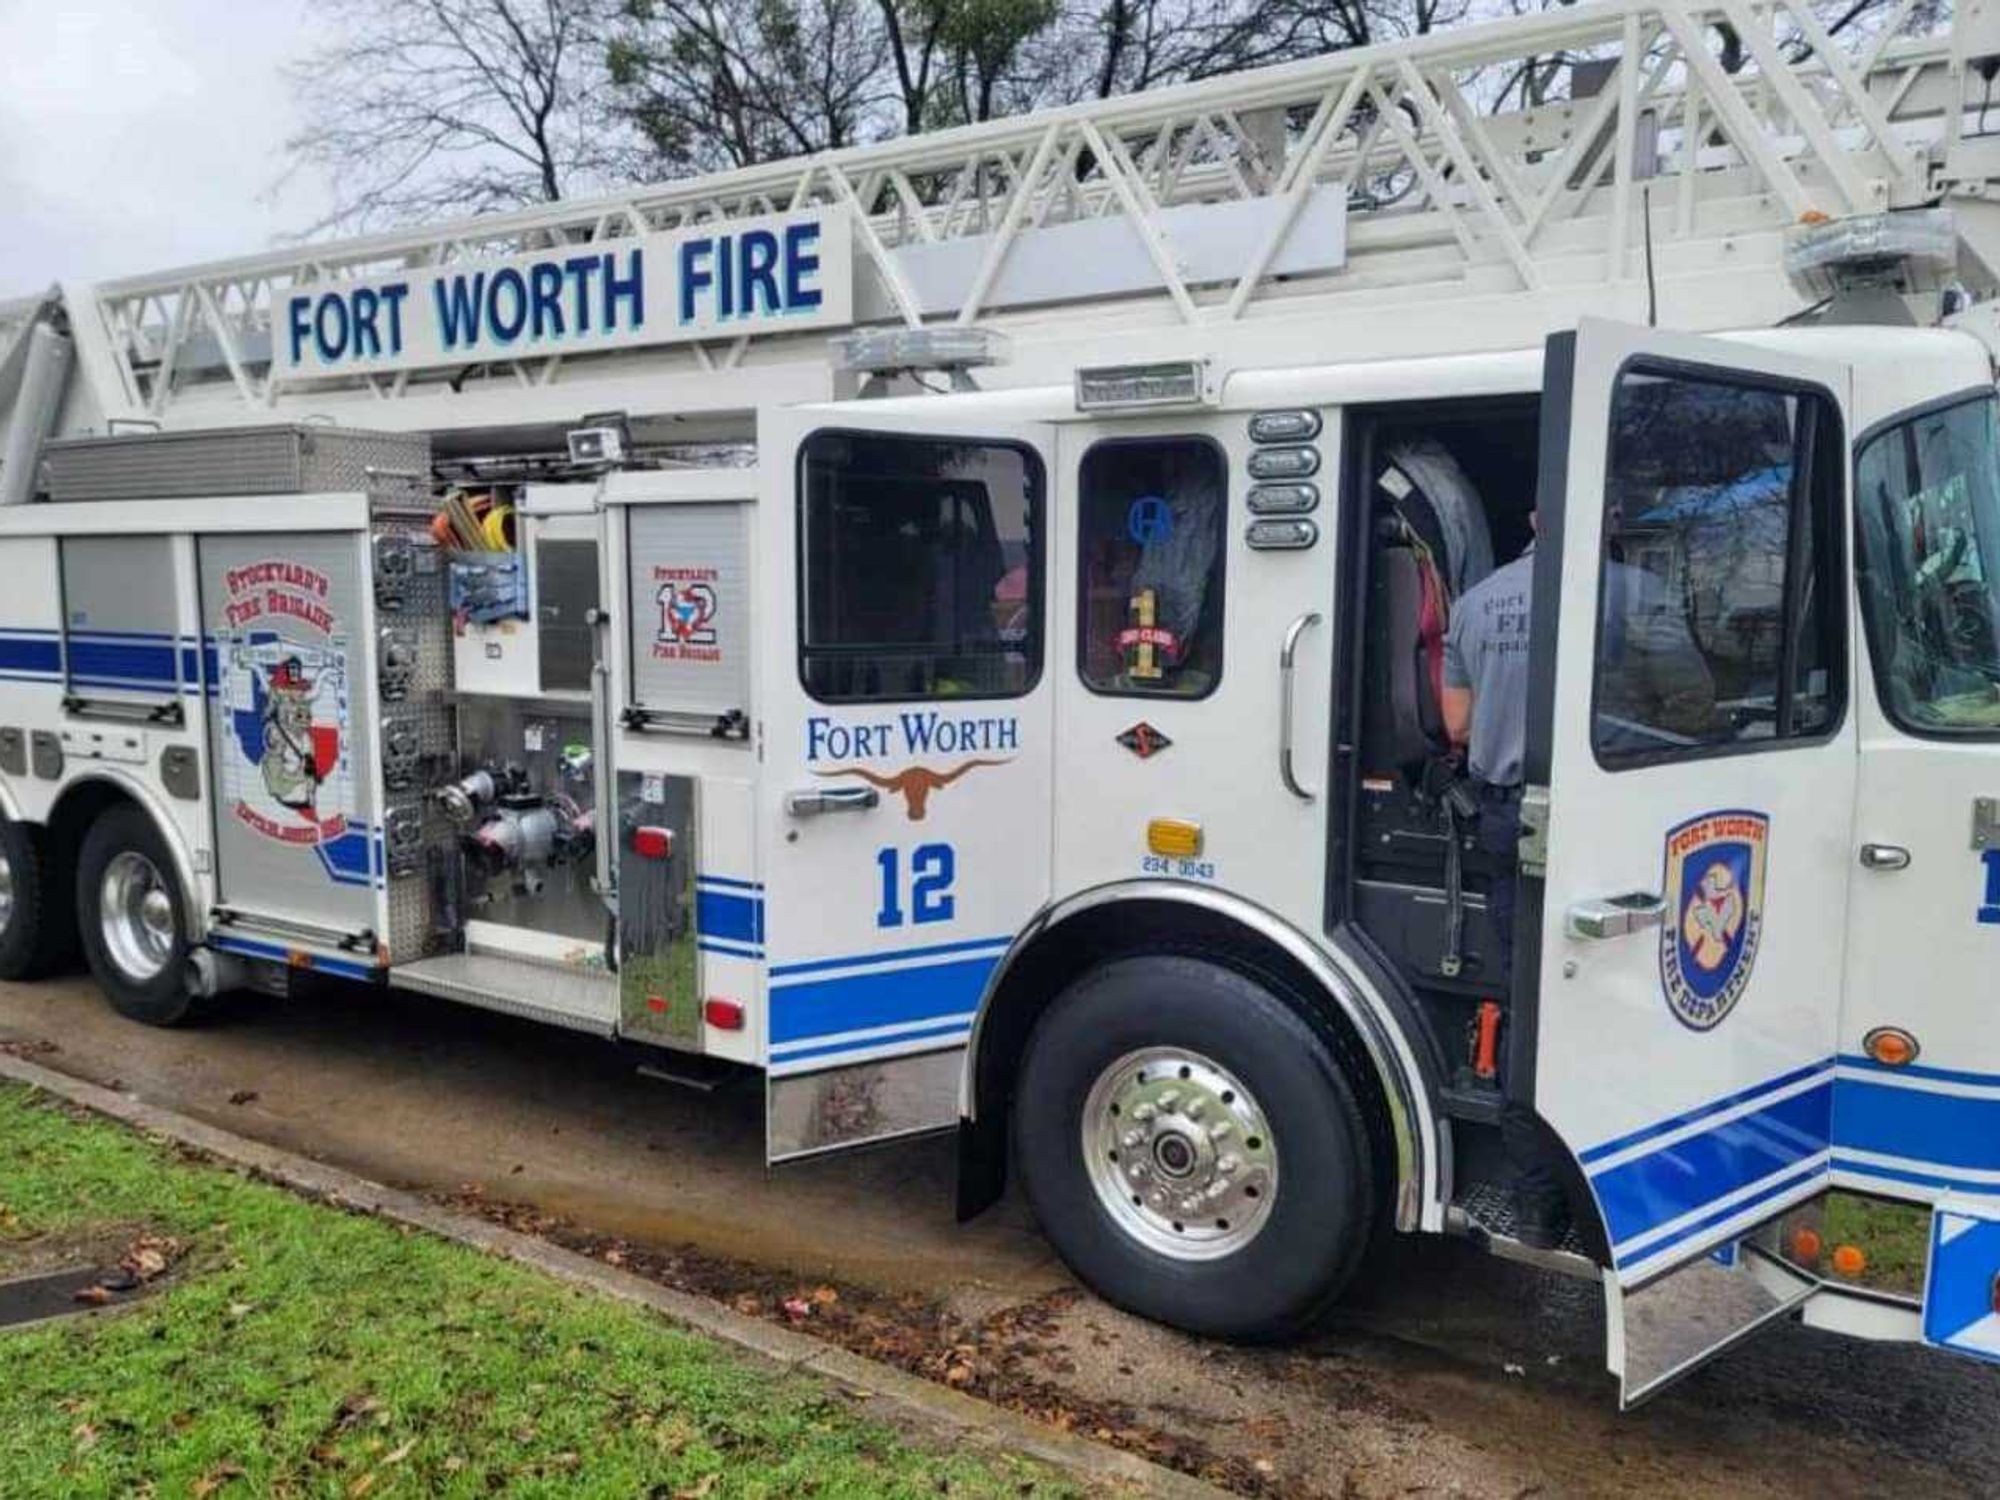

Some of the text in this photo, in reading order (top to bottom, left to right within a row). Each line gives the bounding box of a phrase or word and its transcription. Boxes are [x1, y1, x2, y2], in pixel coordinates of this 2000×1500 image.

[288, 221, 823, 367] FORT WORTH FIRE
[656, 583, 717, 645] 12
[807, 712, 1018, 761] FORT WORTH
[1670, 817, 1765, 857] FORT WORTH
[877, 842, 955, 929] 12
